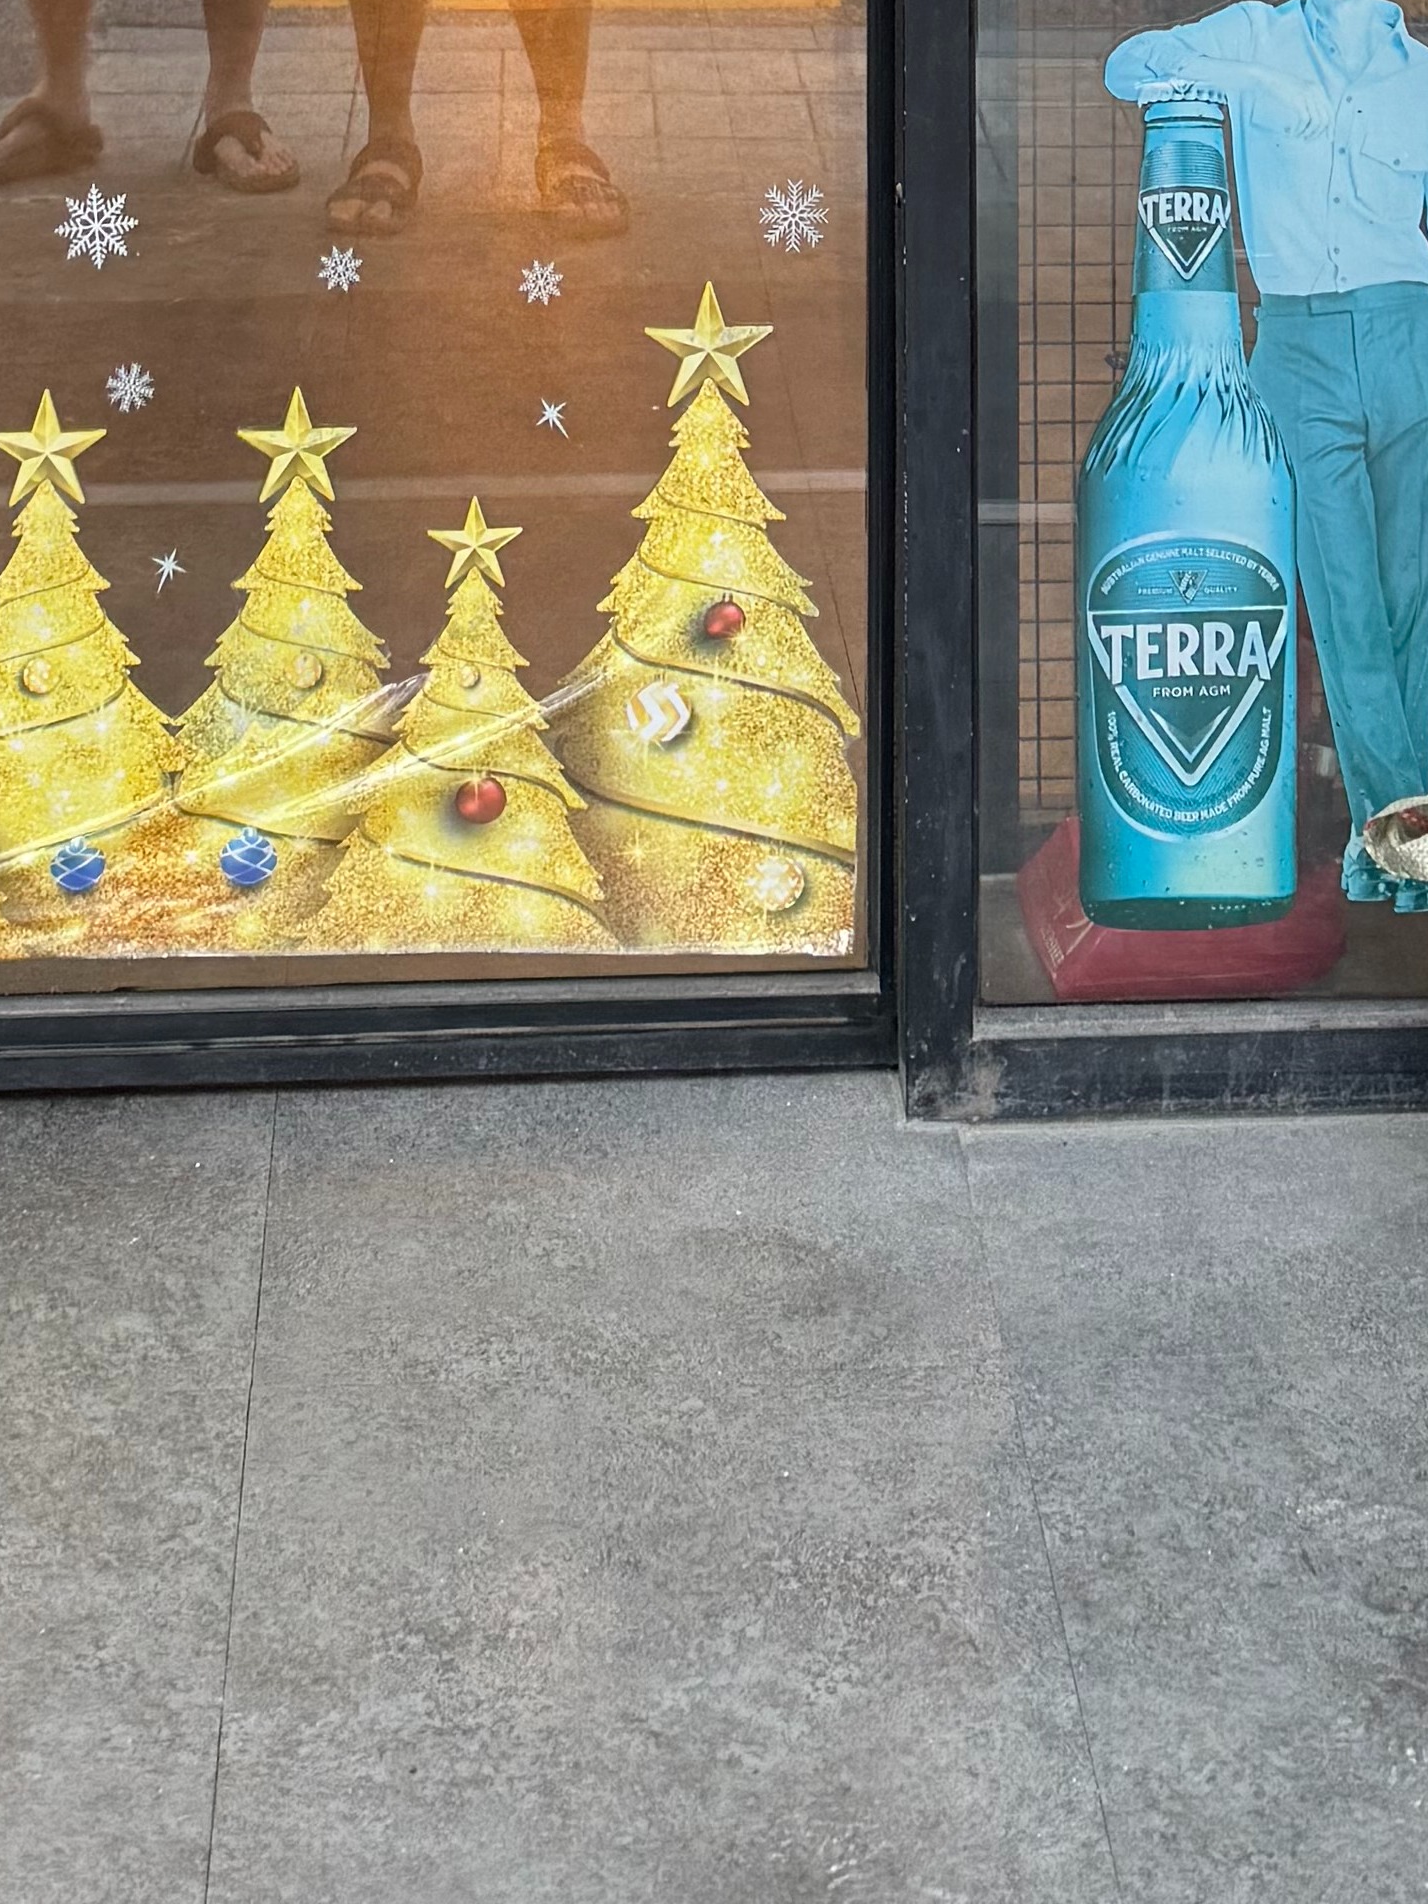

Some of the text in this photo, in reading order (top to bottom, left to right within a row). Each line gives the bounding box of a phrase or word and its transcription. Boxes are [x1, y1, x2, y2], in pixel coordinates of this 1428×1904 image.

[1142, 191, 1228, 231] TERRA
[1100, 620, 1272, 686] TERRA
[1152, 684, 1232, 698] FROM AGM
